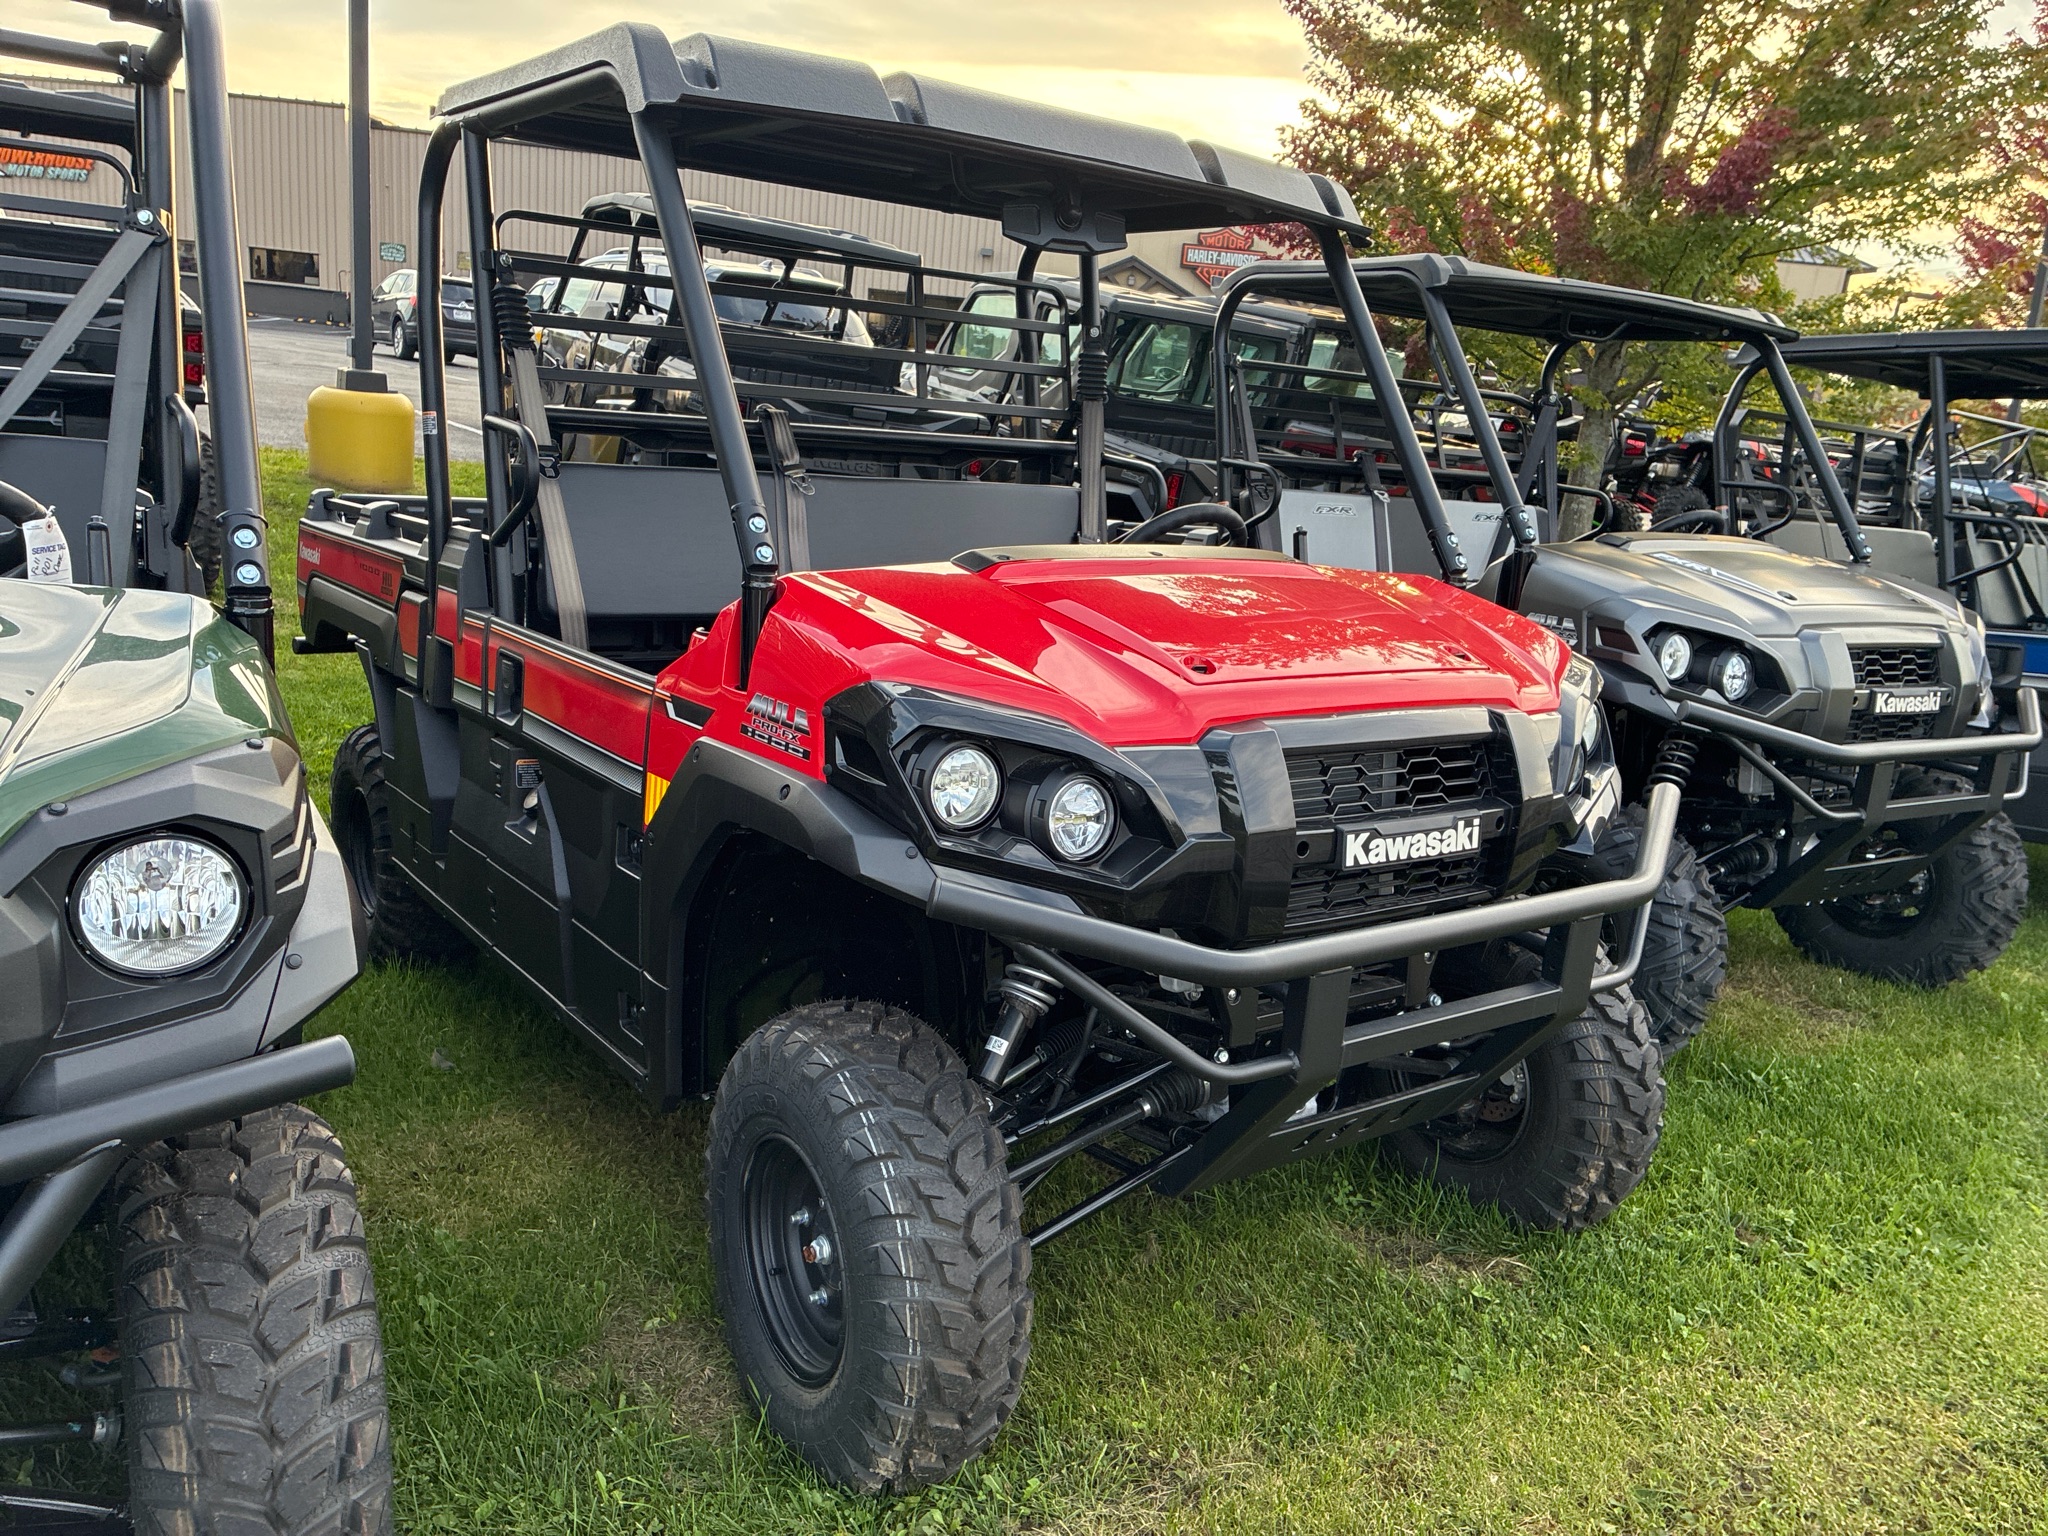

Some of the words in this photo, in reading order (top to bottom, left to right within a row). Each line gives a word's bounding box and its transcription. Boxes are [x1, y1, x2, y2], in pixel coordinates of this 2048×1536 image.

[0, 147, 95, 170] OWERHOUSE
[7, 163, 44, 178] MOTOR
[47, 166, 88, 182] SPORTS
[1206, 232, 1245, 249] MOTOR
[31, 544, 57, 555] SERVICE
[1875, 691, 1942, 713] Kawasaki
[745, 692, 811, 737] MULE
[743, 724, 808, 760] 1000
[1345, 818, 1480, 867] Kawasaki
